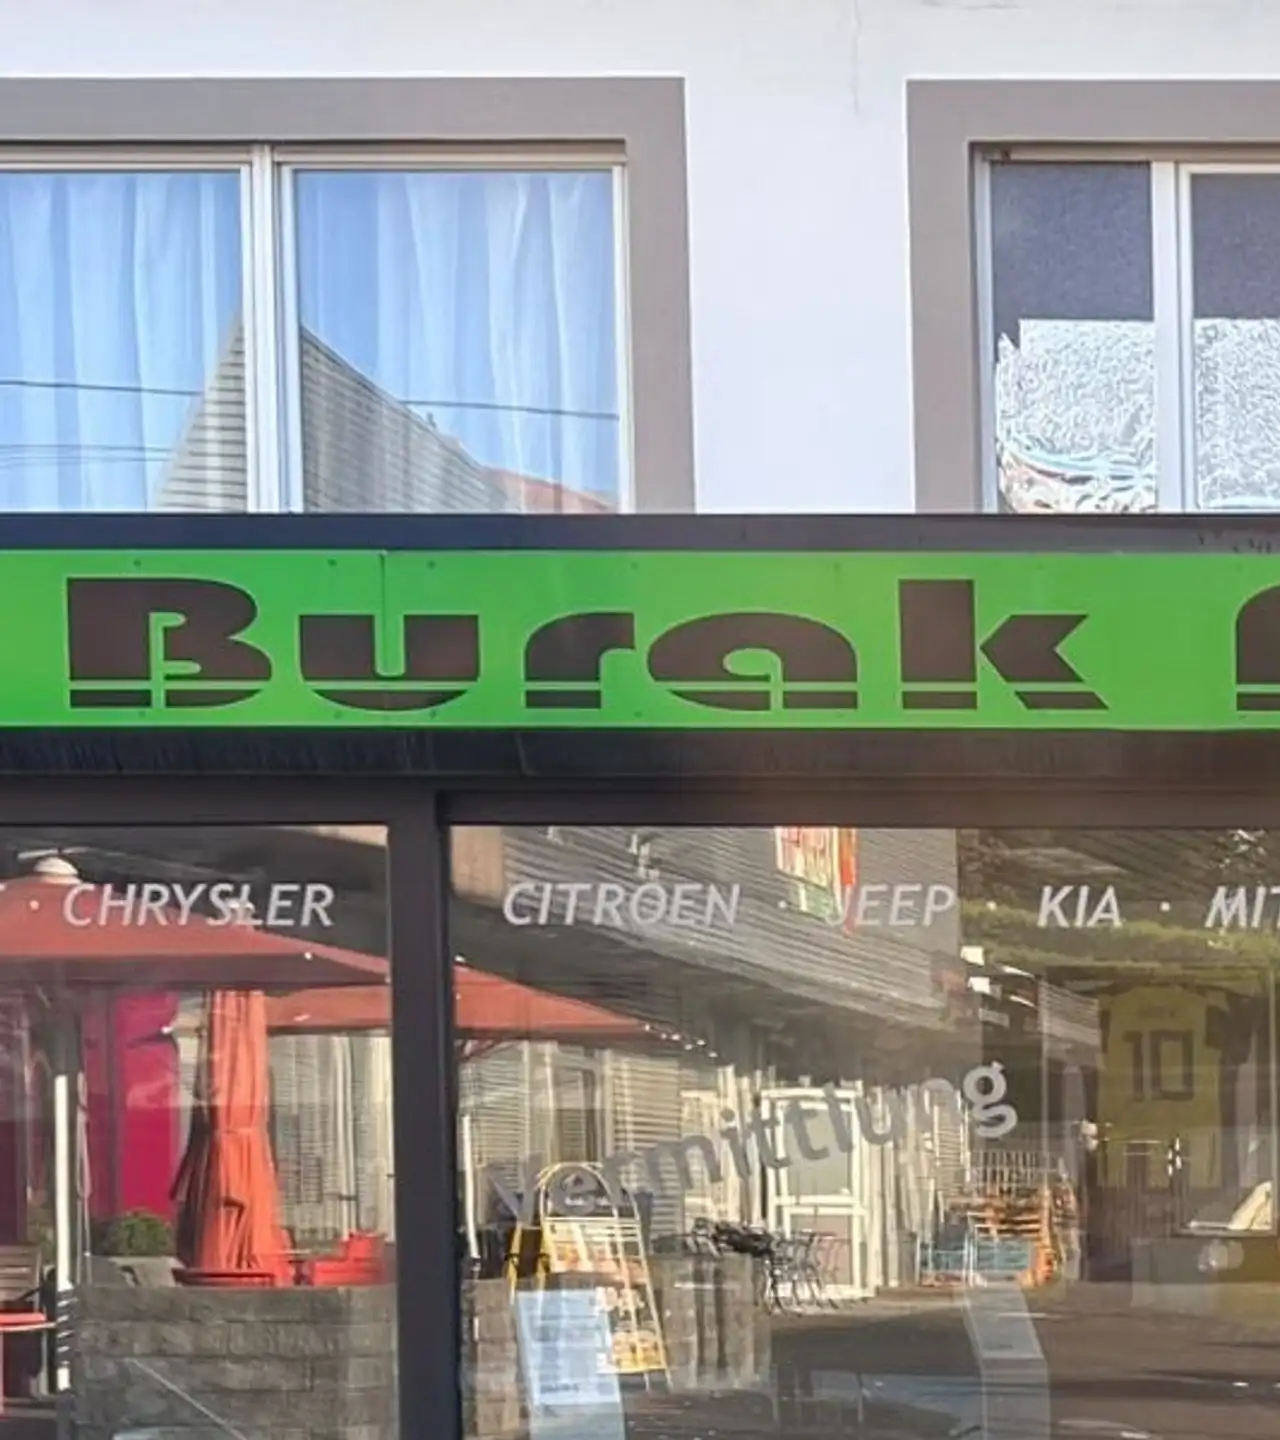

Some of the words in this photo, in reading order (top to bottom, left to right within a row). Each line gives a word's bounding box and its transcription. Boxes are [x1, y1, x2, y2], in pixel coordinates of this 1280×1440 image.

[67, 576, 1109, 710] Burak
[62, 882, 335, 927] CHRYSLER
[824, 884, 956, 927] JEEP
[1037, 884, 1123, 929] KIA
